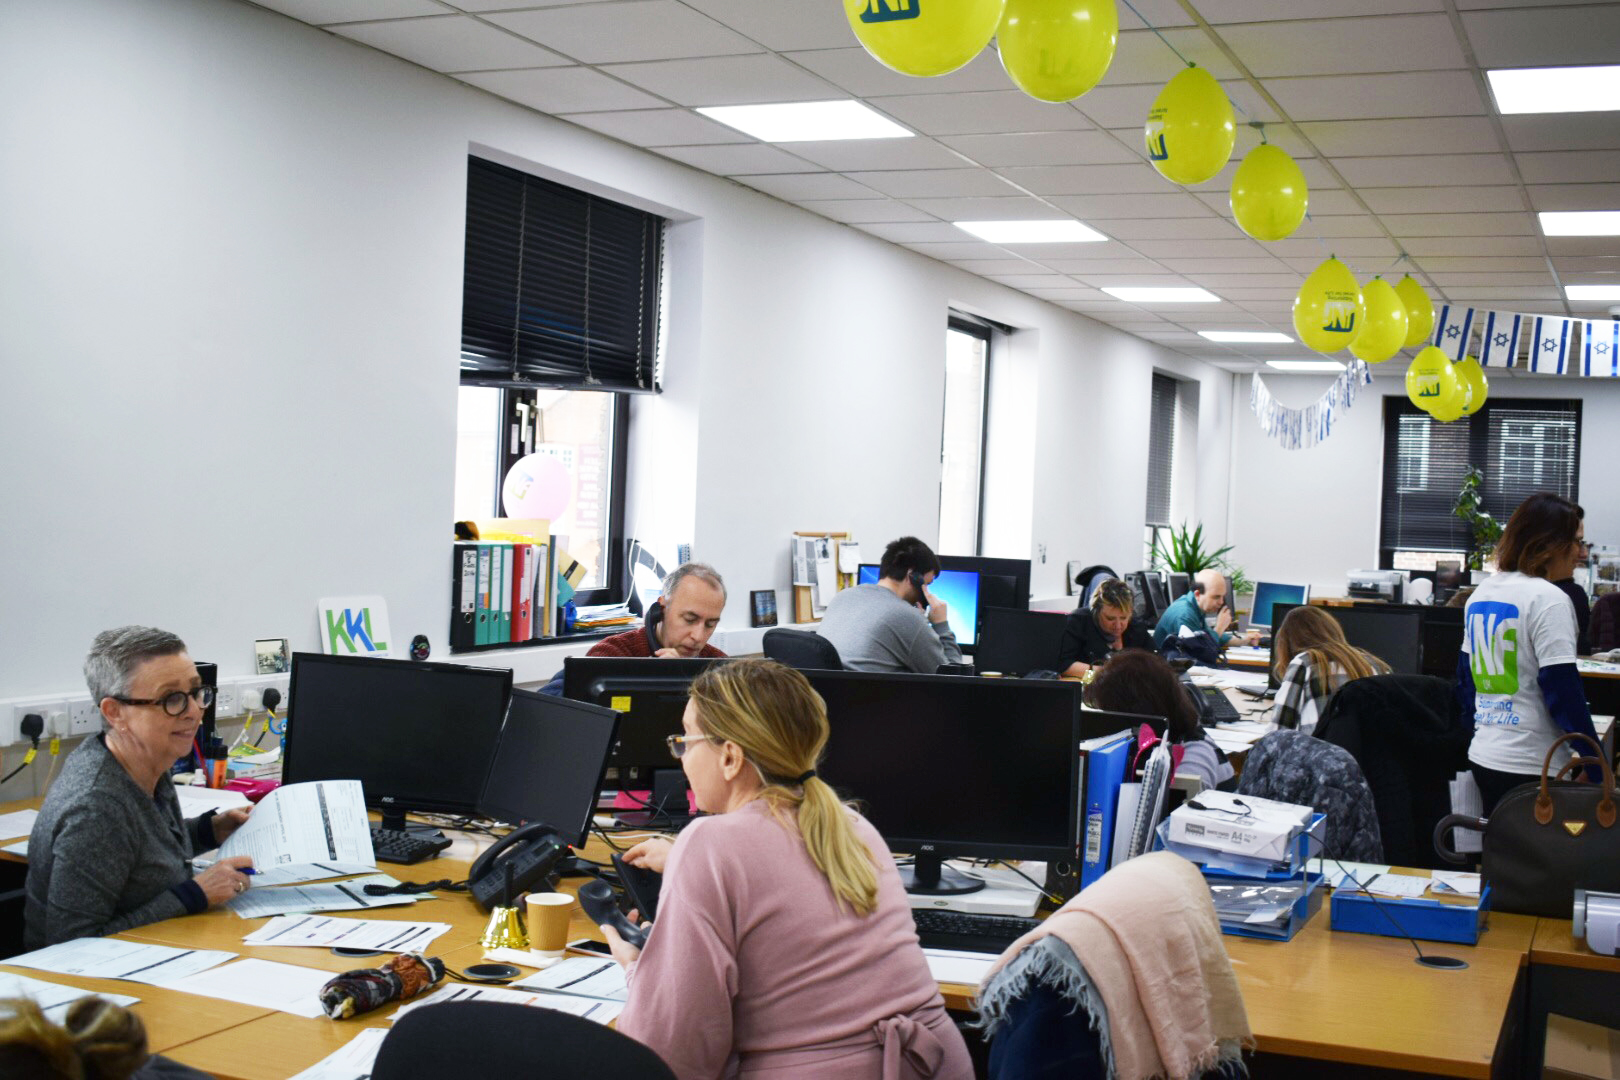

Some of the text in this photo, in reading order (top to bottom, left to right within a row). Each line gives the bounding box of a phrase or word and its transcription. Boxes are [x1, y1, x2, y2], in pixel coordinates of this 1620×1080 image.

[326, 607, 388, 655] KKL
[1497, 712, 1520, 725] Life
[1231, 831, 1243, 842] A4
